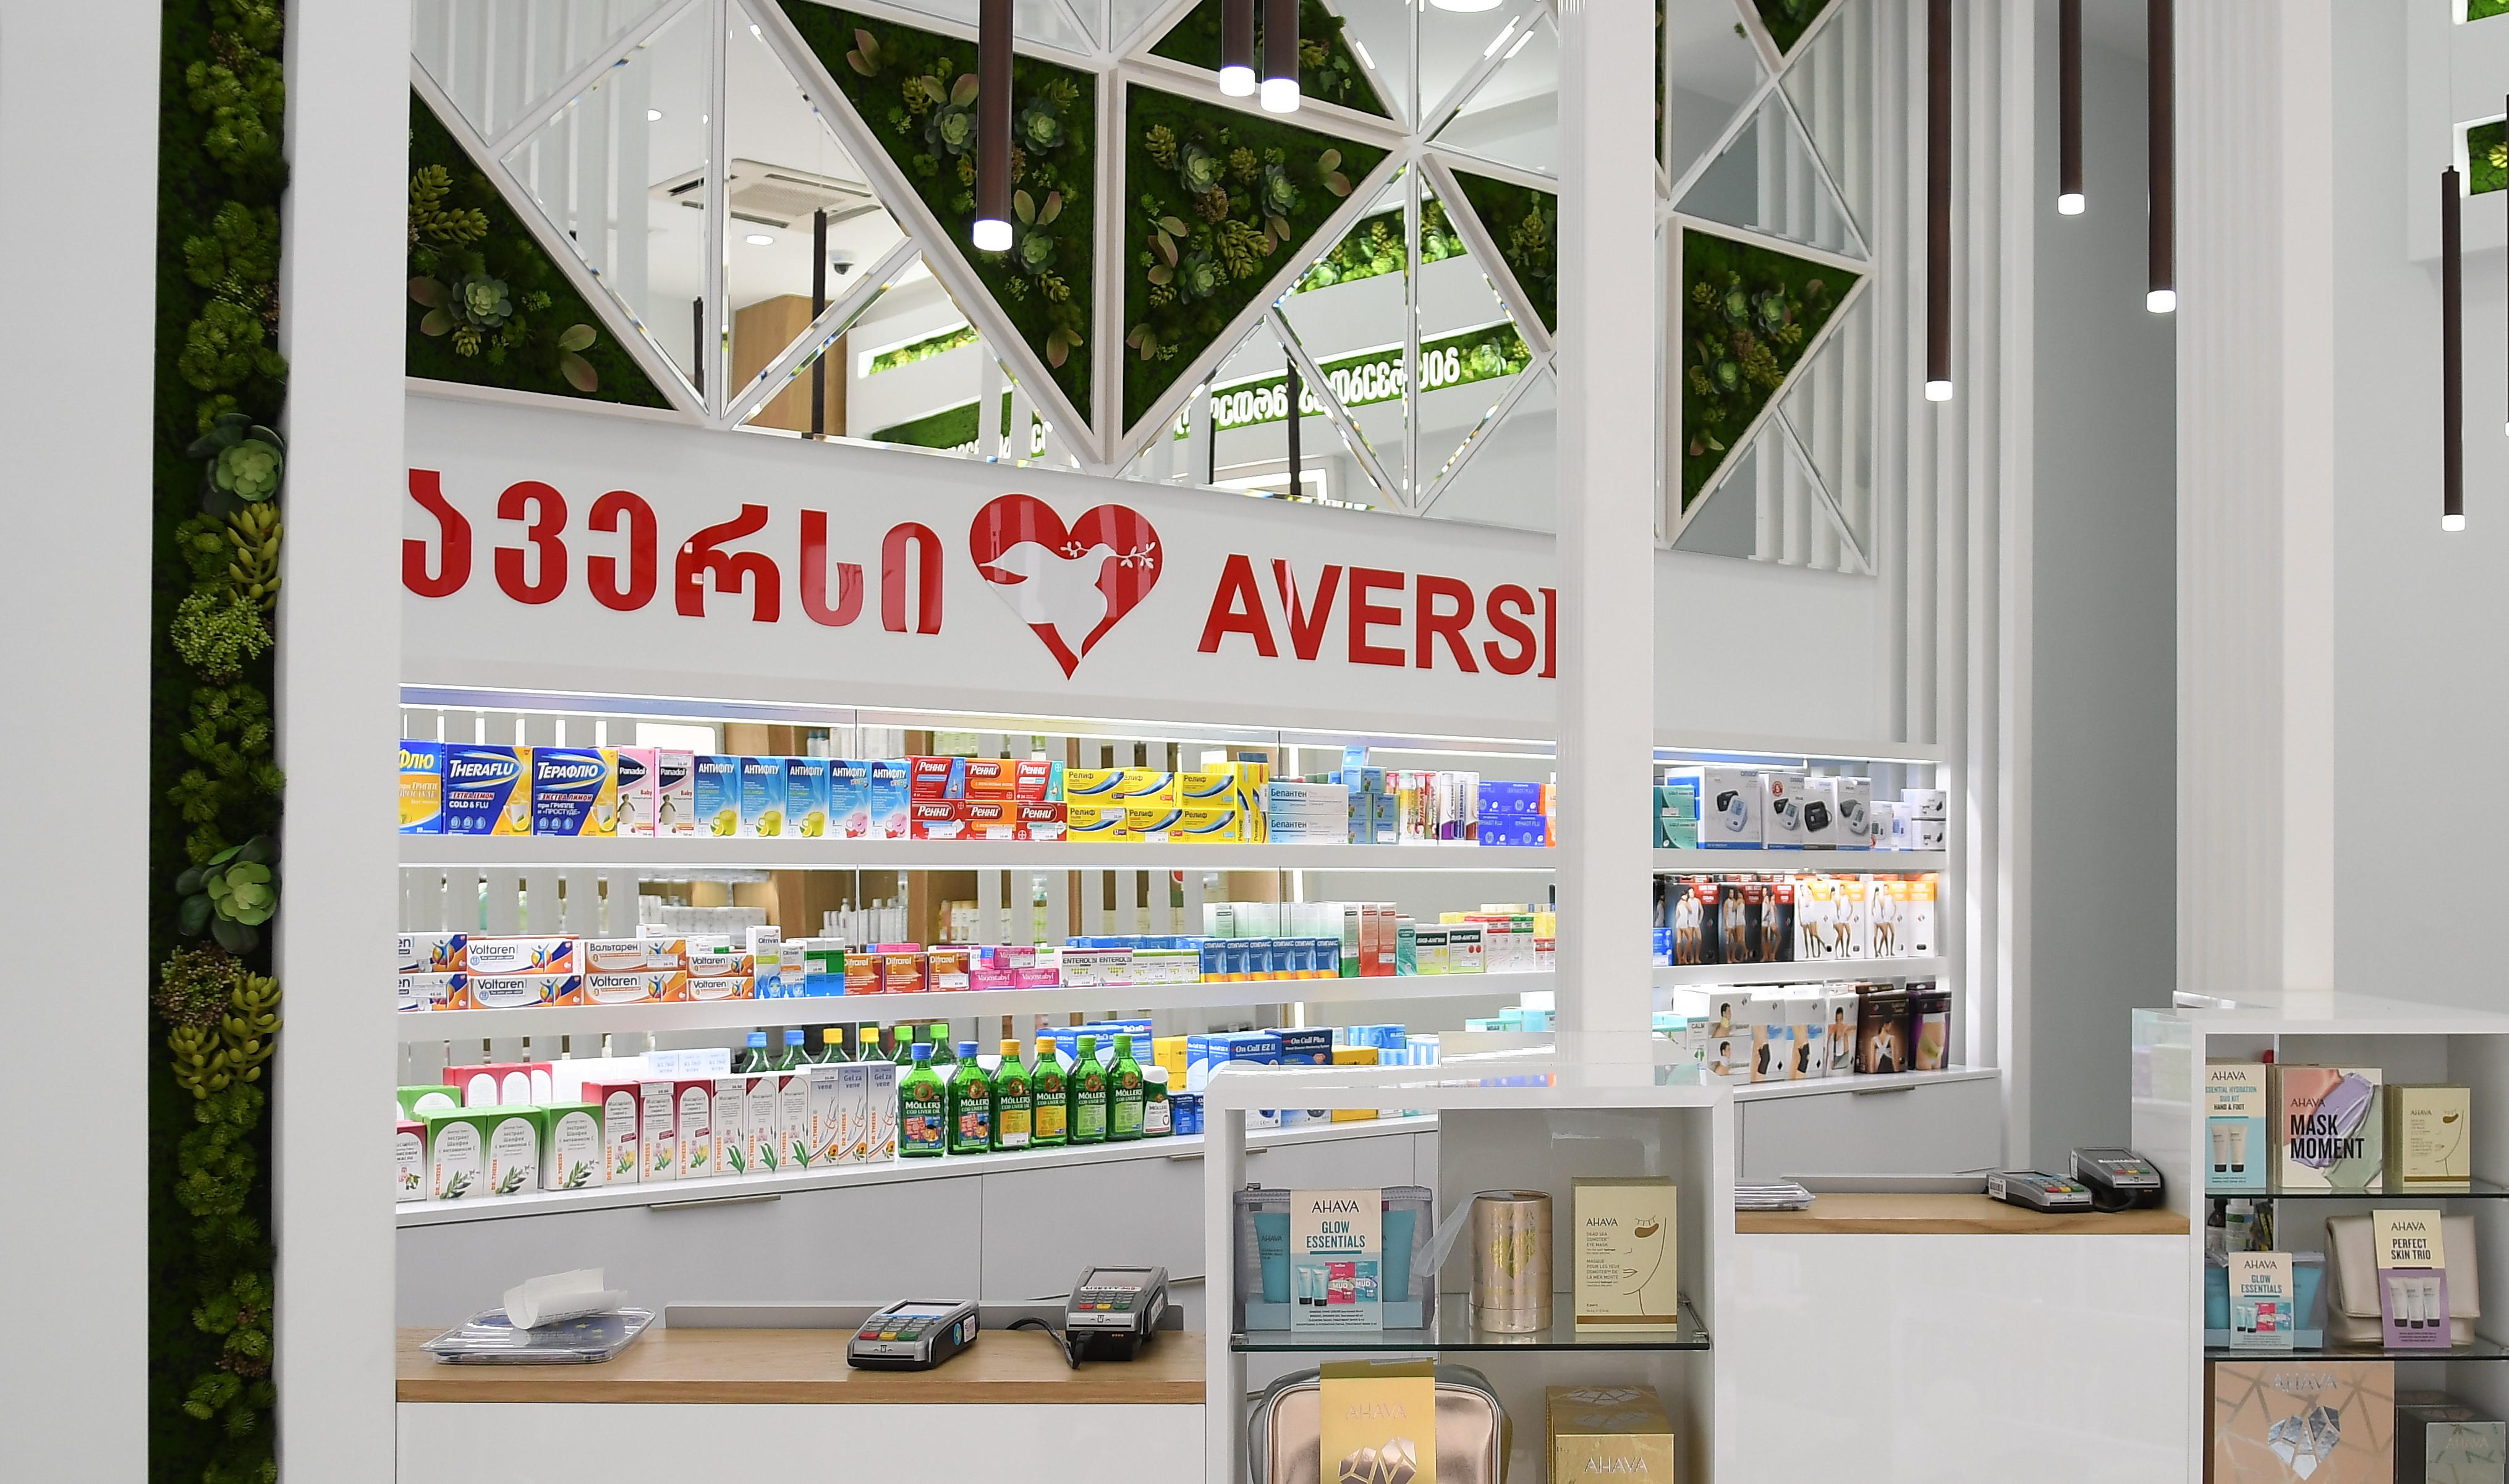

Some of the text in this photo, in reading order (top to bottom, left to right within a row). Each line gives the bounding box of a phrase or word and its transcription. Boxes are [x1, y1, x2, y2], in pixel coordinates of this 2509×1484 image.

[402, 467, 945, 635] ავერსი
[449, 760, 514, 778] THERAFLU
[537, 762, 598, 780] ТЕРАФЛЮ
[619, 767, 646, 775] Panadol
[660, 768, 686, 776] Panadol
[698, 763, 735, 774] АНТИФЛУ
[744, 764, 780, 774] АНТИФЛУ
[789, 766, 824, 776] АНТИФЛУ
[832, 767, 867, 778] АНТИФЛУ
[919, 761, 947, 773] Ренни
[970, 765, 998, 776] Ренни
[1021, 765, 1046, 775] Ренни
[873, 768, 906, 779] АНТИФЛУ
[1068, 771, 1094, 779] Релиф
[1183, 774, 1207, 783] Релиф
[1271, 788, 1307, 797] Бепантен
[917, 805, 951, 816] Ренни
[970, 806, 1000, 817] Ренни
[1022, 807, 1053, 818] Ренни
[1069, 808, 1095, 816] Релиф
[1129, 809, 1153, 817] Релиф
[1184, 810, 1208, 819] Релиф
[1271, 820, 1307, 828] Бепантен
[469, 944, 516, 955] Voltaren
[590, 943, 639, 952] Вольтарен
[692, 956, 726, 965] Voltaren
[886, 957, 912, 965] Difrarel
[477, 978, 524, 989] Voltaren
[590, 975, 638, 987] Voltaren
[694, 980, 727, 988] Voltaren
[2211, 1071, 2246, 1081] AHAVA
[2290, 1098, 2325, 1108] AHAVA
[2290, 1114, 2338, 1136] MASK
[2290, 1137, 2365, 1160] MOMENT
[1311, 1200, 1360, 1213] AHAVA
[1322, 1221, 1350, 1234] GLOW
[1586, 1217, 1618, 1227] AHAVA
[2390, 1221, 2427, 1232] AHAVA
[1306, 1235, 1365, 1249] ESSENTIALS
[2392, 1238, 2427, 1249] PERFECT
[2391, 1249, 2432, 1260] SKIN TRIO
[2244, 1260, 2278, 1270] AHAVA
[2251, 1274, 2271, 1284] GLOW
[2241, 1284, 2283, 1294] ESSENTIALS
[2272, 1373, 2338, 1391] AHAVA
[1346, 1404, 1407, 1420] AHAVA
[2446, 1436, 2489, 1450] AHAVA
[1583, 1457, 1649, 1473] AHAVA
